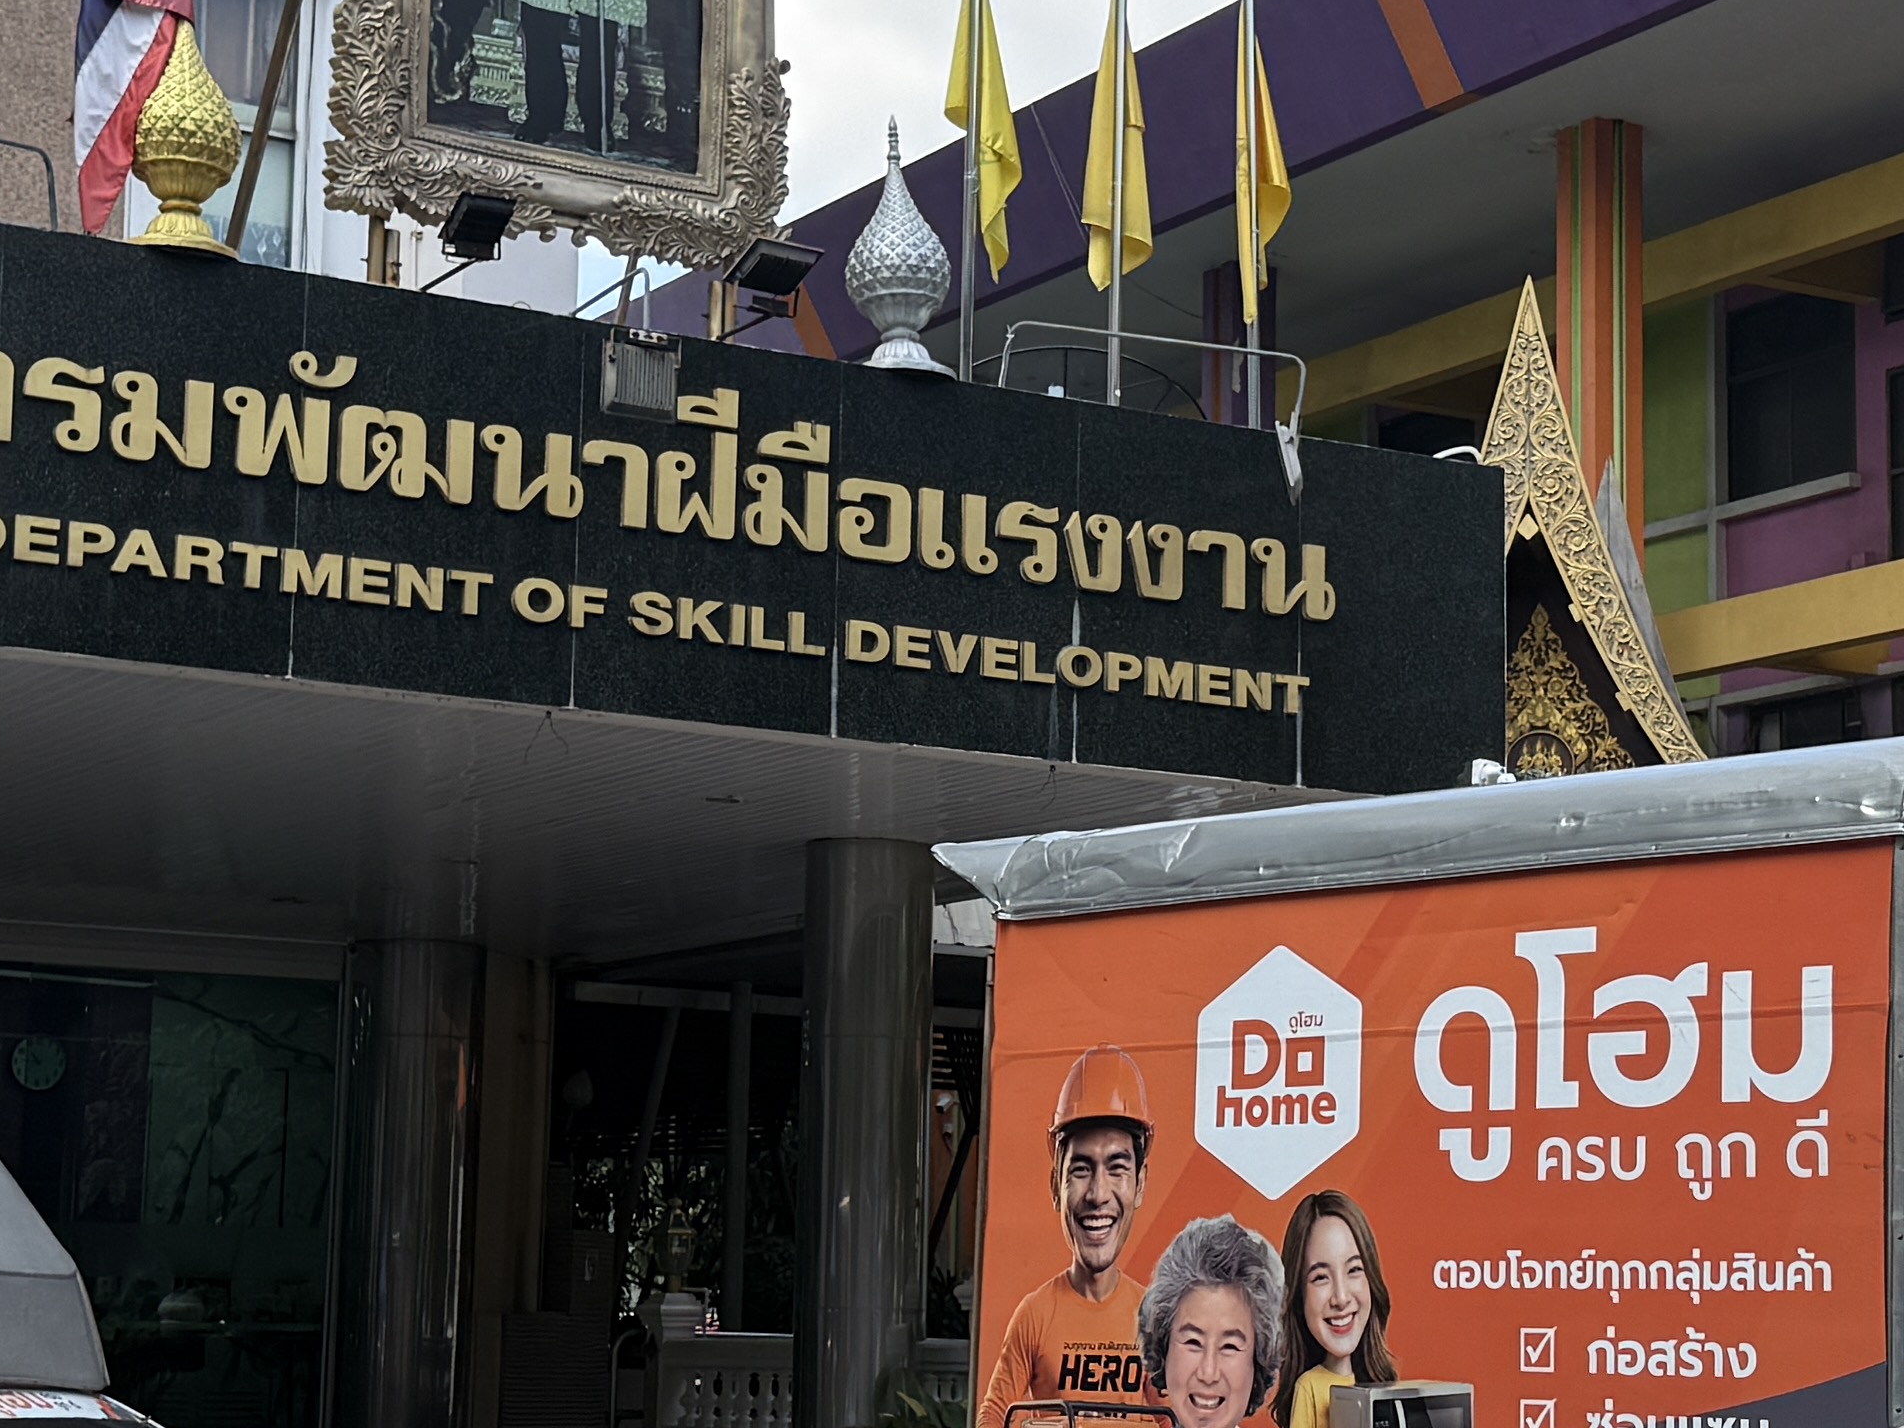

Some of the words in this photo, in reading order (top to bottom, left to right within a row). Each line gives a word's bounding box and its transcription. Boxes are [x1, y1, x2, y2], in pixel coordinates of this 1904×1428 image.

[511, 575, 609, 630] OF
[629, 590, 826, 658] SKILL
[843, 617, 1312, 716] DEVELOPMENT
[1414, 926, 1835, 1182] ดูโฮม
[1215, 1085, 1337, 1128] home
[1537, 1133, 1646, 1184] ครบ
[1674, 1129, 1757, 1202] ถูก
[1786, 1107, 1830, 1180] ดี
[1432, 1247, 1833, 1304] ตอบโจทย์ทุกกลุ่มสินค้า
[1057, 1353, 1144, 1393] HERO
[1585, 1326, 1758, 1380] ก่อสร้าง
